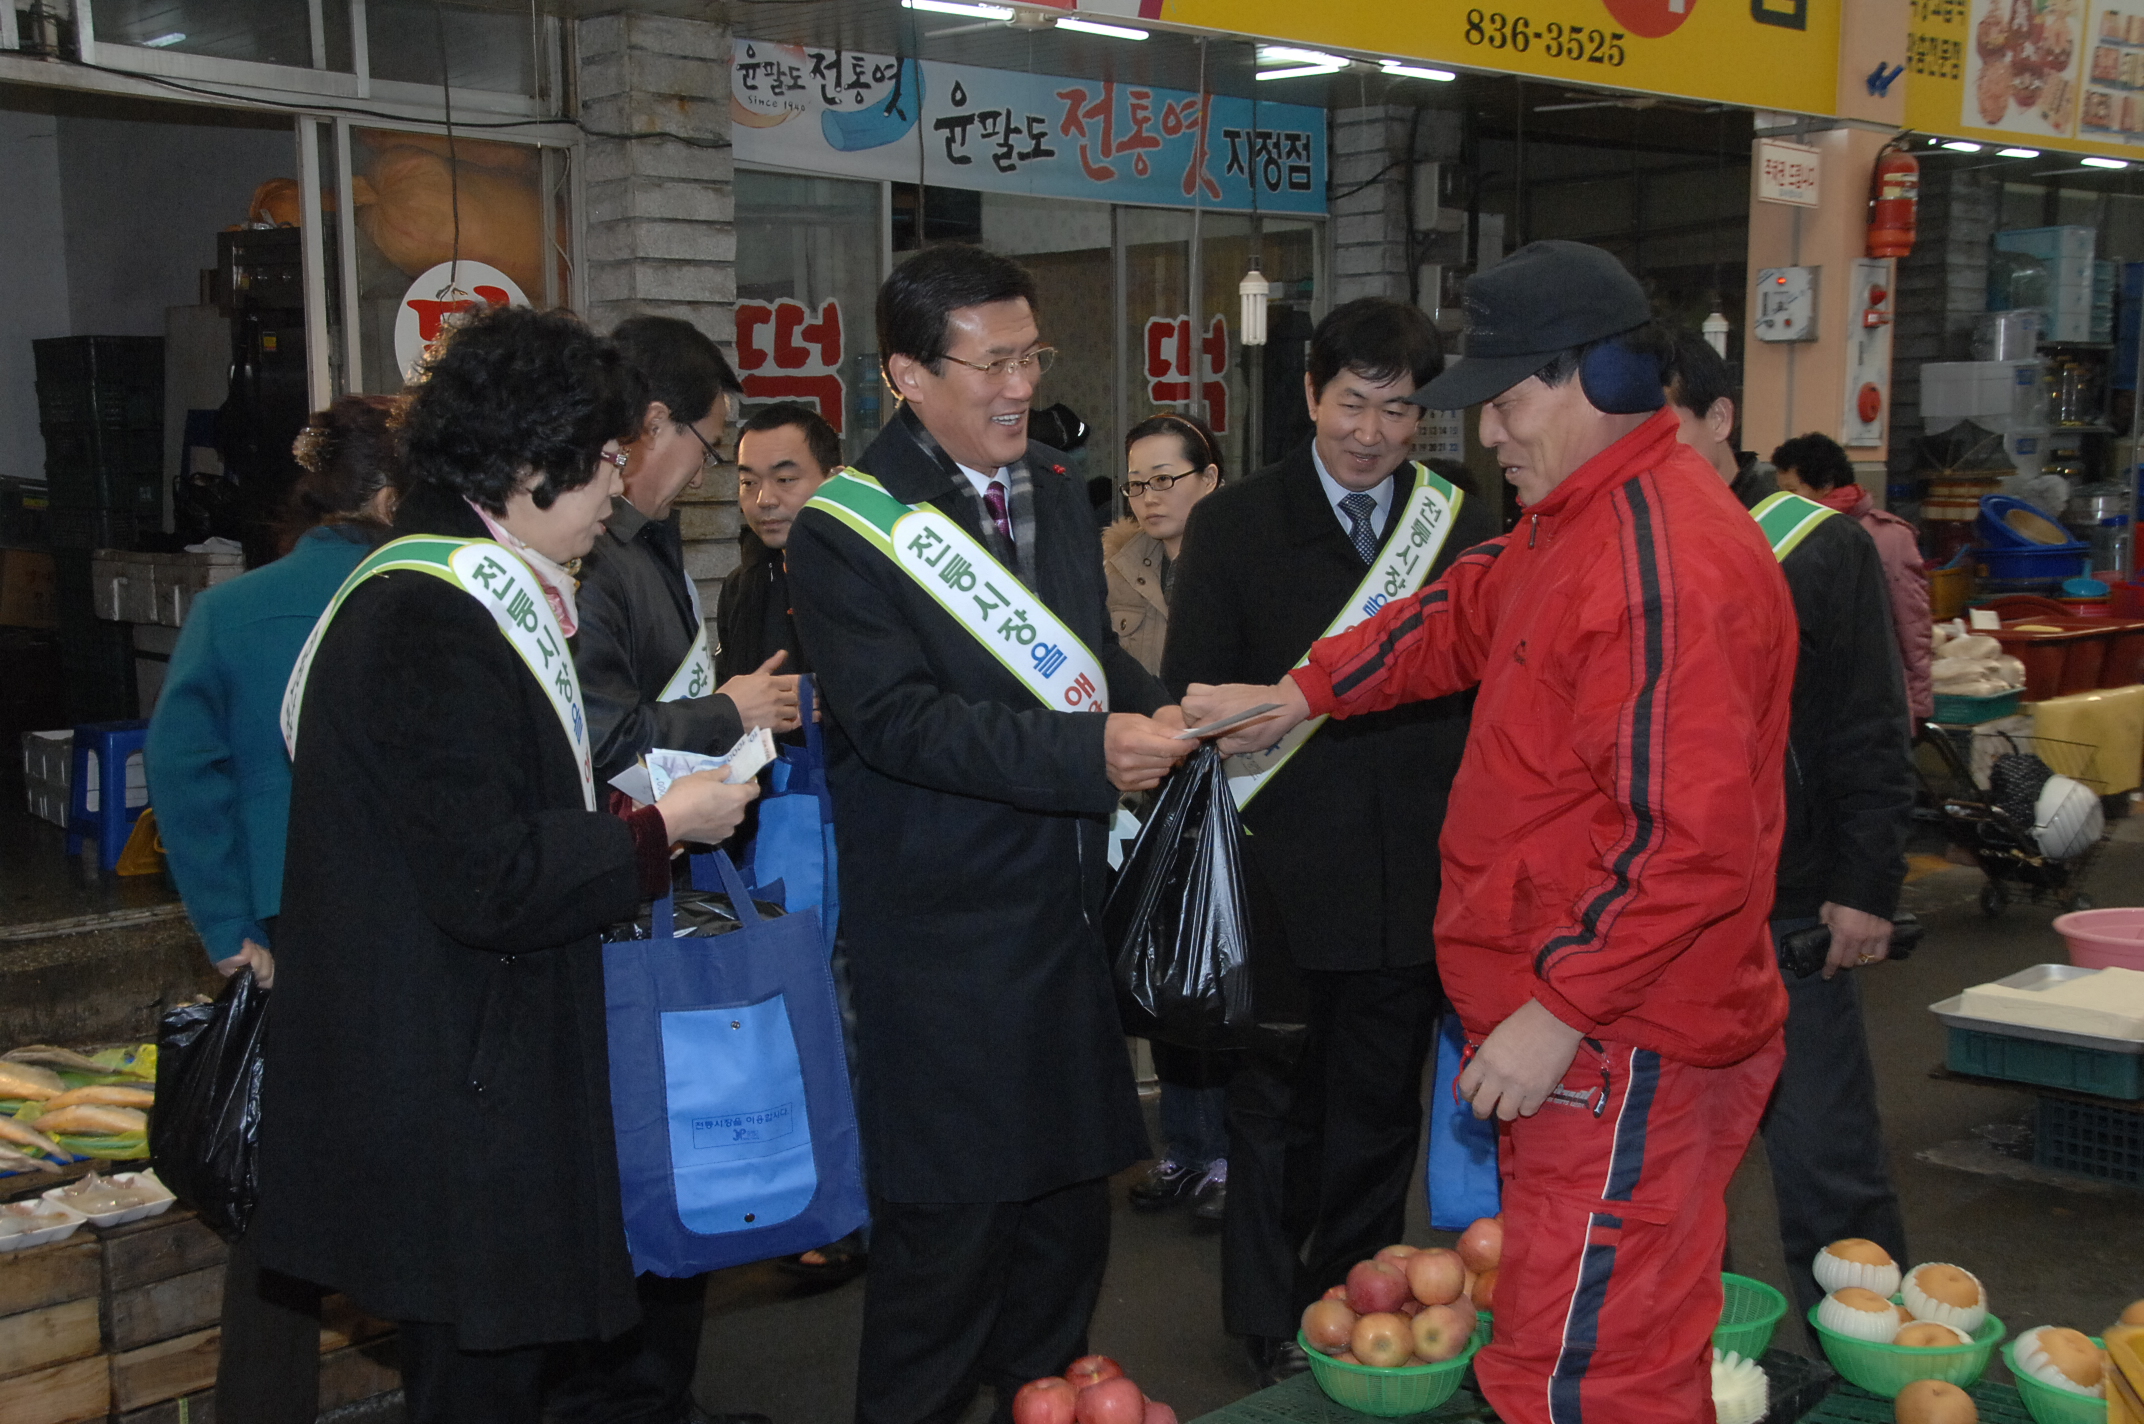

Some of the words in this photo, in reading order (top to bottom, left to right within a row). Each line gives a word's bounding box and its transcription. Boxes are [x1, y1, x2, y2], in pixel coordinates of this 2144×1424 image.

[736, 44, 806, 97] 윤팔도
[808, 49, 907, 121] 전통엿
[1464, 8, 1626, 68] 836-3525
[748, 95, 778, 108] since
[784, 100, 806, 112] 1940
[933, 81, 1056, 172] 윤팔도
[1056, 83, 1222, 200] 전통엿
[1223, 127, 1311, 193] 지정점
[735, 302, 843, 433] 떡
[1148, 320, 1227, 434] 떡
[907, 526, 1067, 679] 전통시장을
[1362, 496, 1442, 618] 전통시장을
[472, 556, 584, 746] 전통시장을
